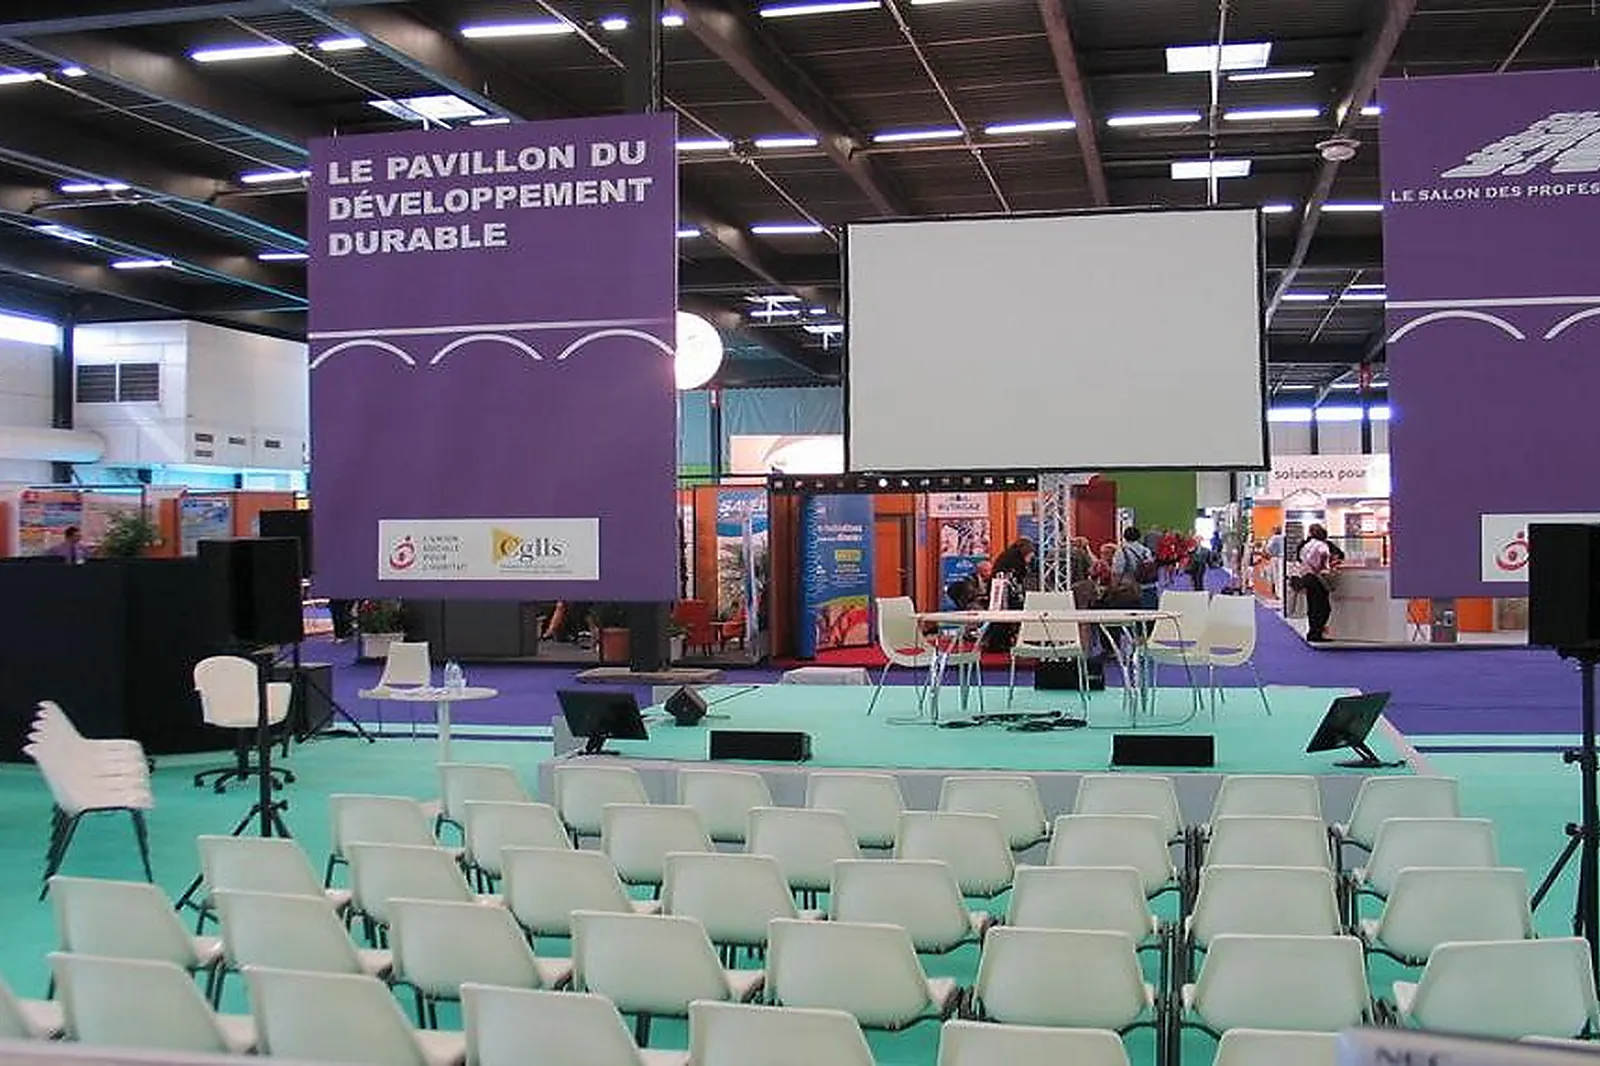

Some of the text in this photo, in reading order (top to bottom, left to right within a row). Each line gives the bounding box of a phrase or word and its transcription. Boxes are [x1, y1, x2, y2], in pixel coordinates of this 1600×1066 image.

[328, 140, 647, 185] LE PAVILLON DU
[328, 177, 653, 221] DÉVELOPPEMENT
[1390, 189, 1414, 202] LE
[1418, 187, 1480, 202] SALON
[1485, 184, 1522, 199] DES
[328, 222, 509, 257] DURABLE
[1274, 466, 1334, 480] solutions
